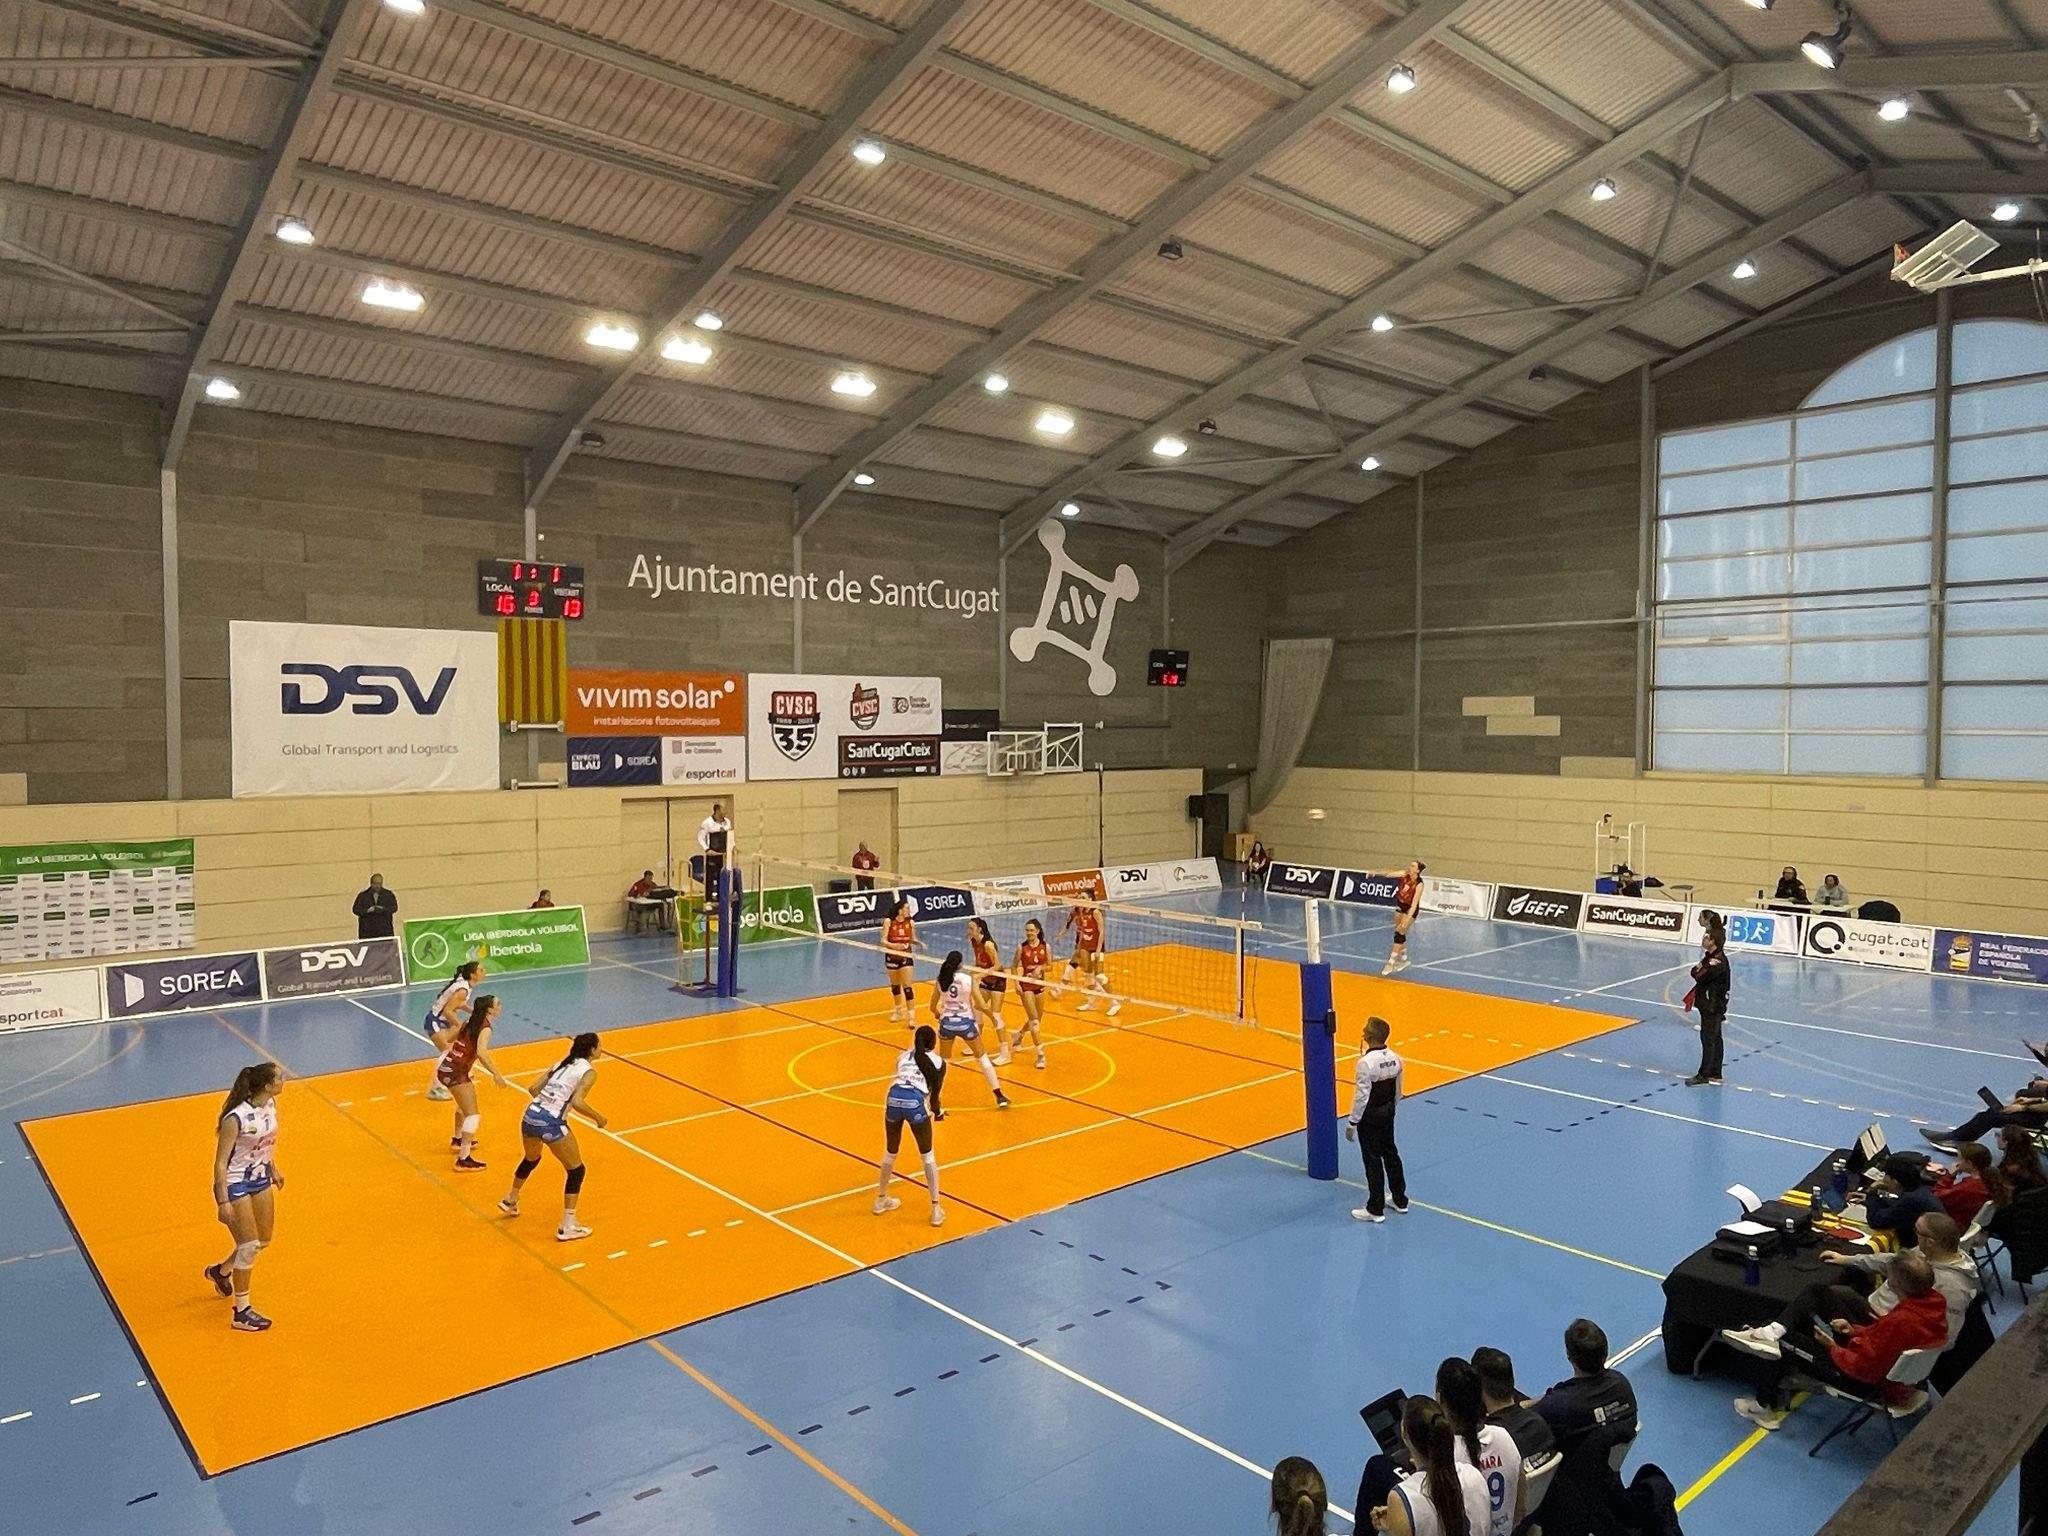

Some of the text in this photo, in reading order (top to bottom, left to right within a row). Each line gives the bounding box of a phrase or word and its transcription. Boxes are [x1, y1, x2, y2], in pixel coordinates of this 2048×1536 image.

[628, 554, 1000, 619] Ajuntament de SantCugat
[281, 663, 457, 715] DSV
[776, 695, 813, 715] CVSC
[852, 699, 879, 717] CVSC
[775, 727, 815, 751] 35
[282, 744, 459, 757] Global Transport and Logistics
[848, 742, 931, 761] SantCugatCreix
[686, 768, 737, 780] esportcat
[1119, 869, 1148, 882] DSV
[1285, 867, 1321, 883] DSV
[837, 895, 877, 915] DSV
[925, 894, 966, 911] SOREA
[1524, 900, 1569, 918] GEFF
[1592, 907, 1676, 928] SantCugatCreix
[464, 933, 485, 942] LIGA
[1849, 932, 1929, 949] cugat.cat
[490, 942, 543, 957] Iberdrola
[301, 946, 369, 972] DSV
[160, 969, 244, 995] SOREA
[0, 1007, 64, 1025] sportcat
[1487, 1471, 1505, 1512] 9
